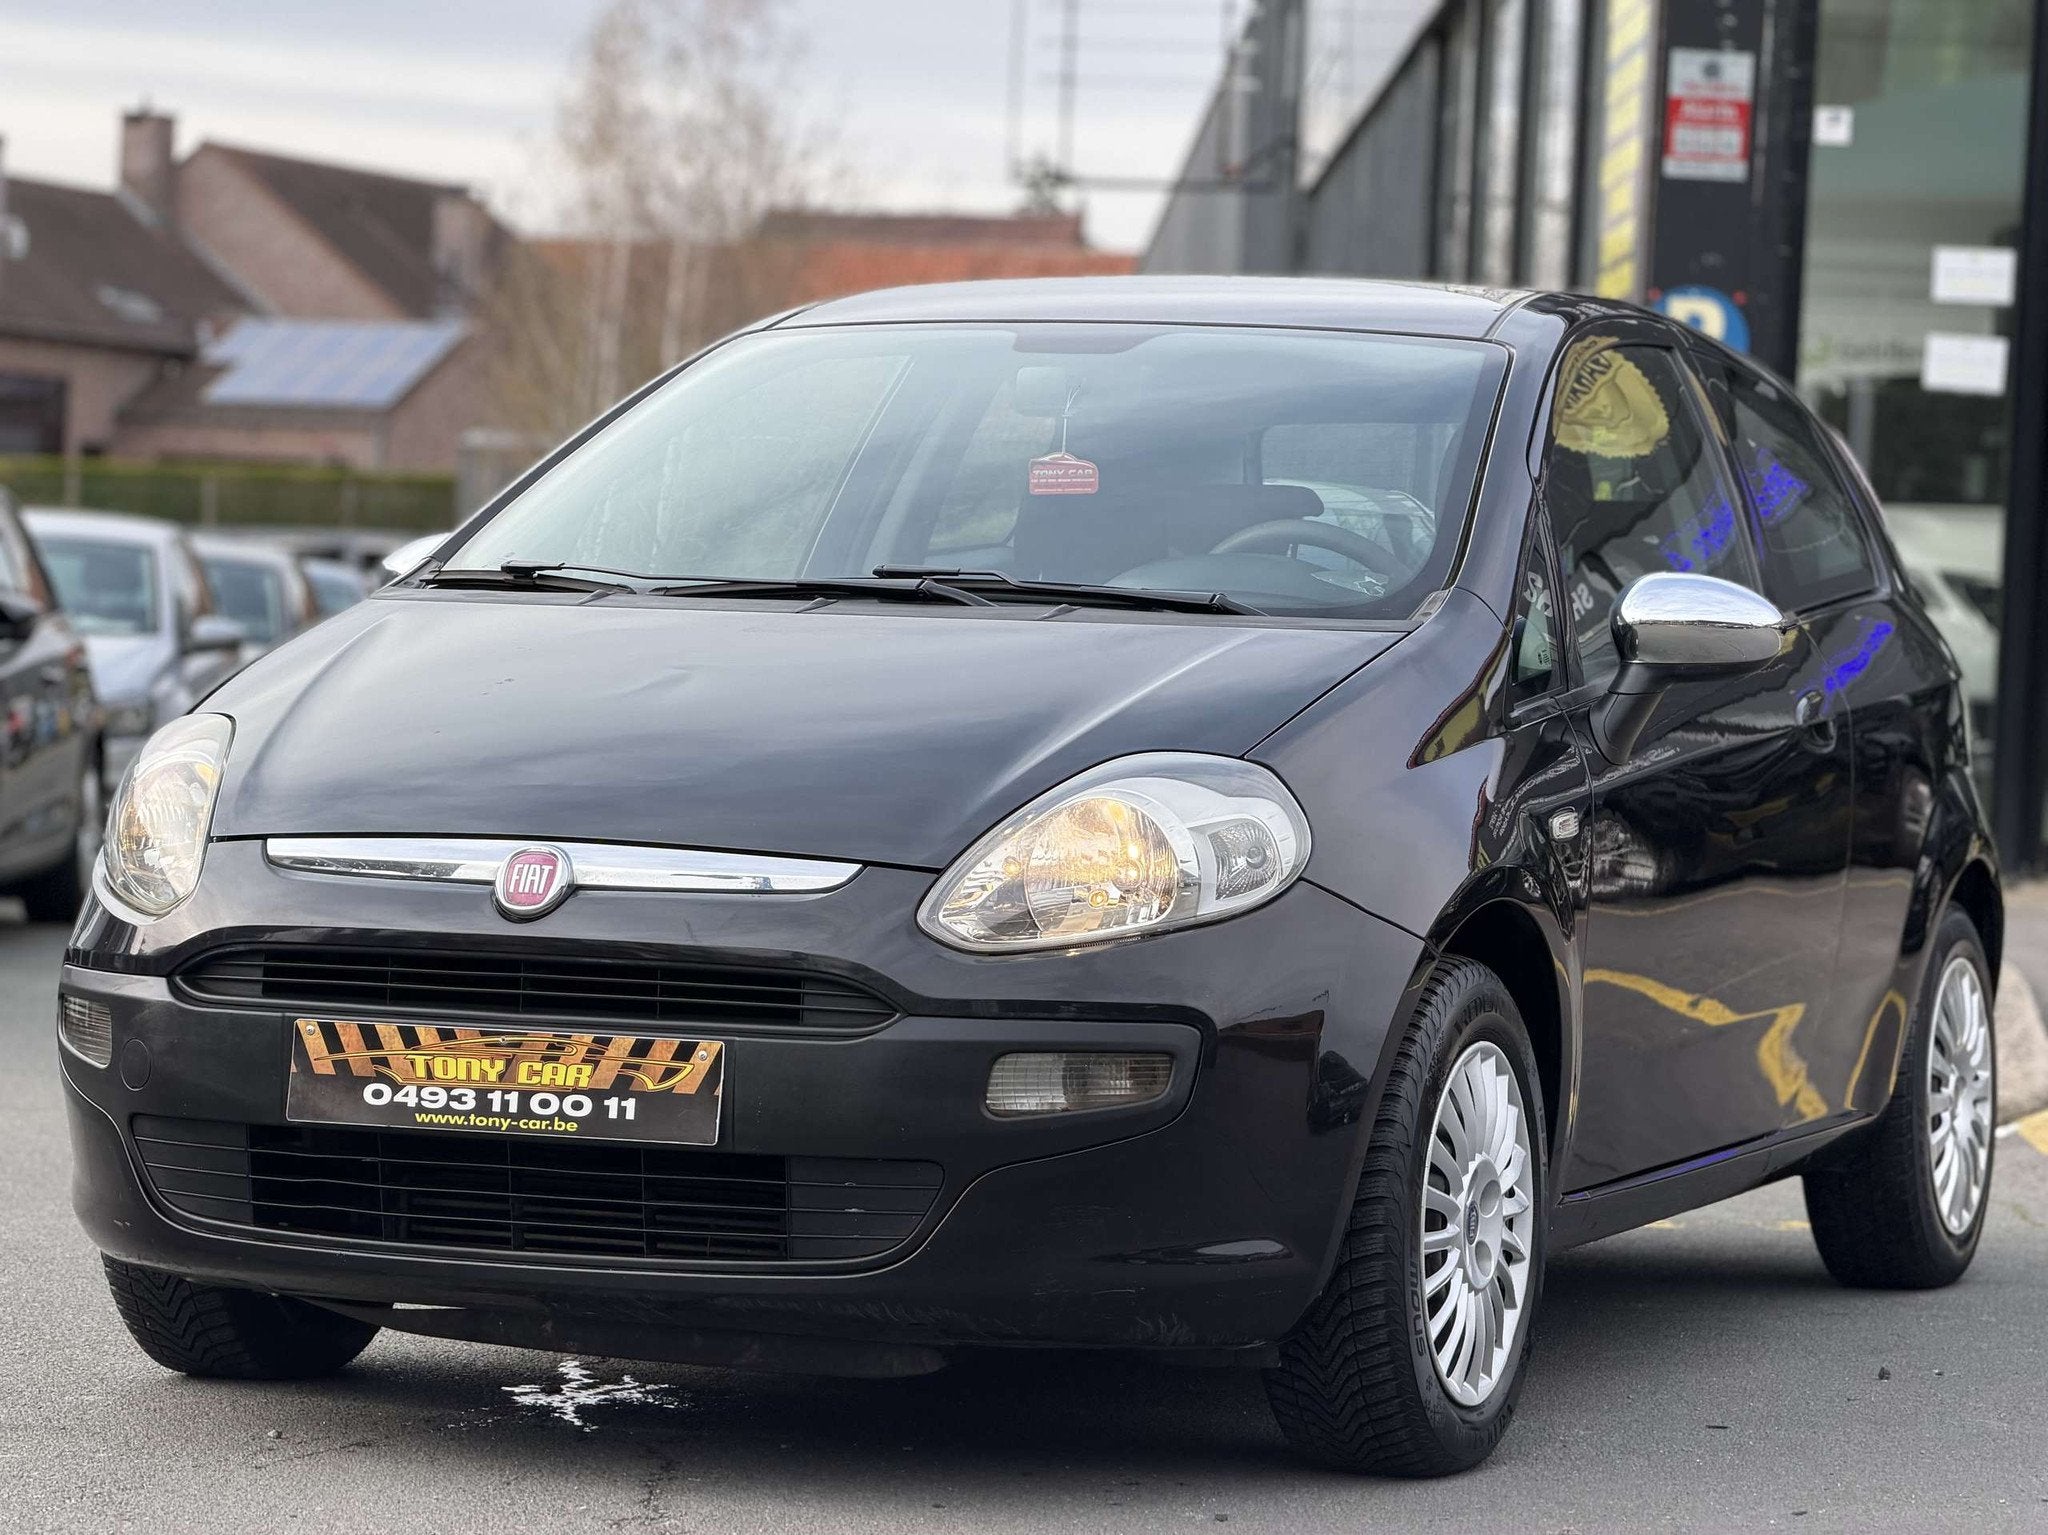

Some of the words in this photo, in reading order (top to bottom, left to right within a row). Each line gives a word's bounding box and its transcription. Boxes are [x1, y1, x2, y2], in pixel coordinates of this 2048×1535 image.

[1032, 468, 1065, 476] TONY
[508, 863, 554, 895] FIAT
[403, 1053, 505, 1083] TONY
[516, 1060, 594, 1089] CAR
[362, 1082, 477, 1112] 0493
[486, 1087, 520, 1114] 11
[529, 1092, 593, 1118] 00
[603, 1096, 637, 1121] 11
[414, 1112, 578, 1132] www.tony-car.be
